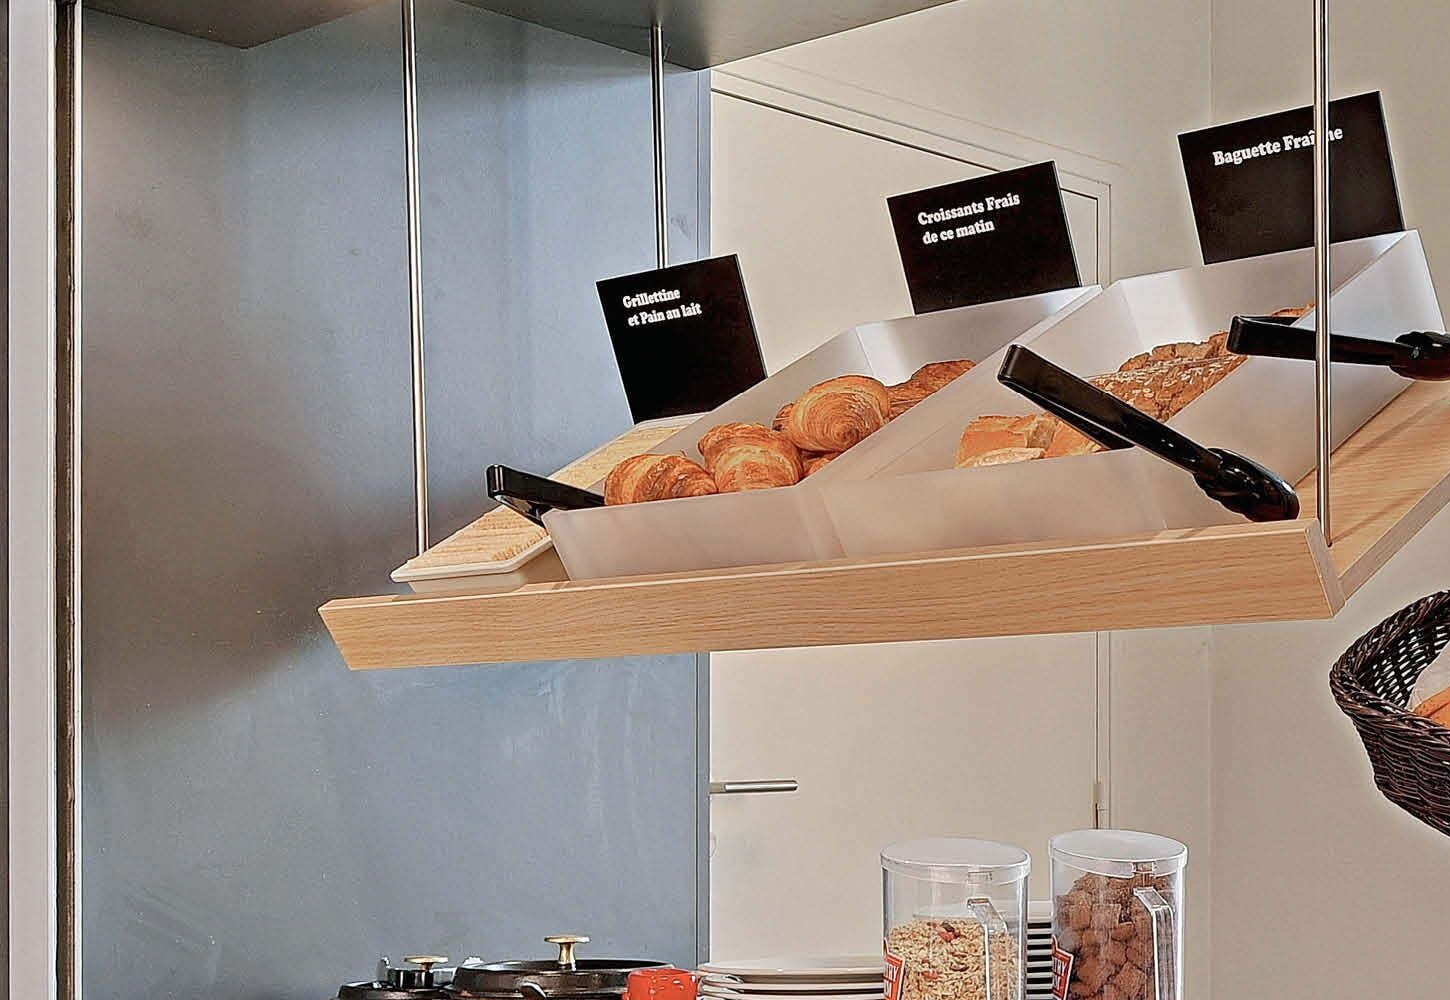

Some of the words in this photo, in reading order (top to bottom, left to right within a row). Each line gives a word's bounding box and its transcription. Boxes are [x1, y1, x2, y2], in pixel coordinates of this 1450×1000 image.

[1212, 141, 1281, 165] Baguette
[1282, 128, 1343, 150] Fraîhe
[918, 202, 984, 225] Croissants
[985, 193, 1020, 210] Frais
[922, 231, 938, 244] de
[940, 229, 954, 240] ce
[956, 219, 995, 238] matin
[623, 289, 680, 308] Grillettine
[628, 315, 639, 326] et
[640, 310, 665, 324] Pain
[667, 308, 680, 320] au
[680, 302, 702, 317] lait
